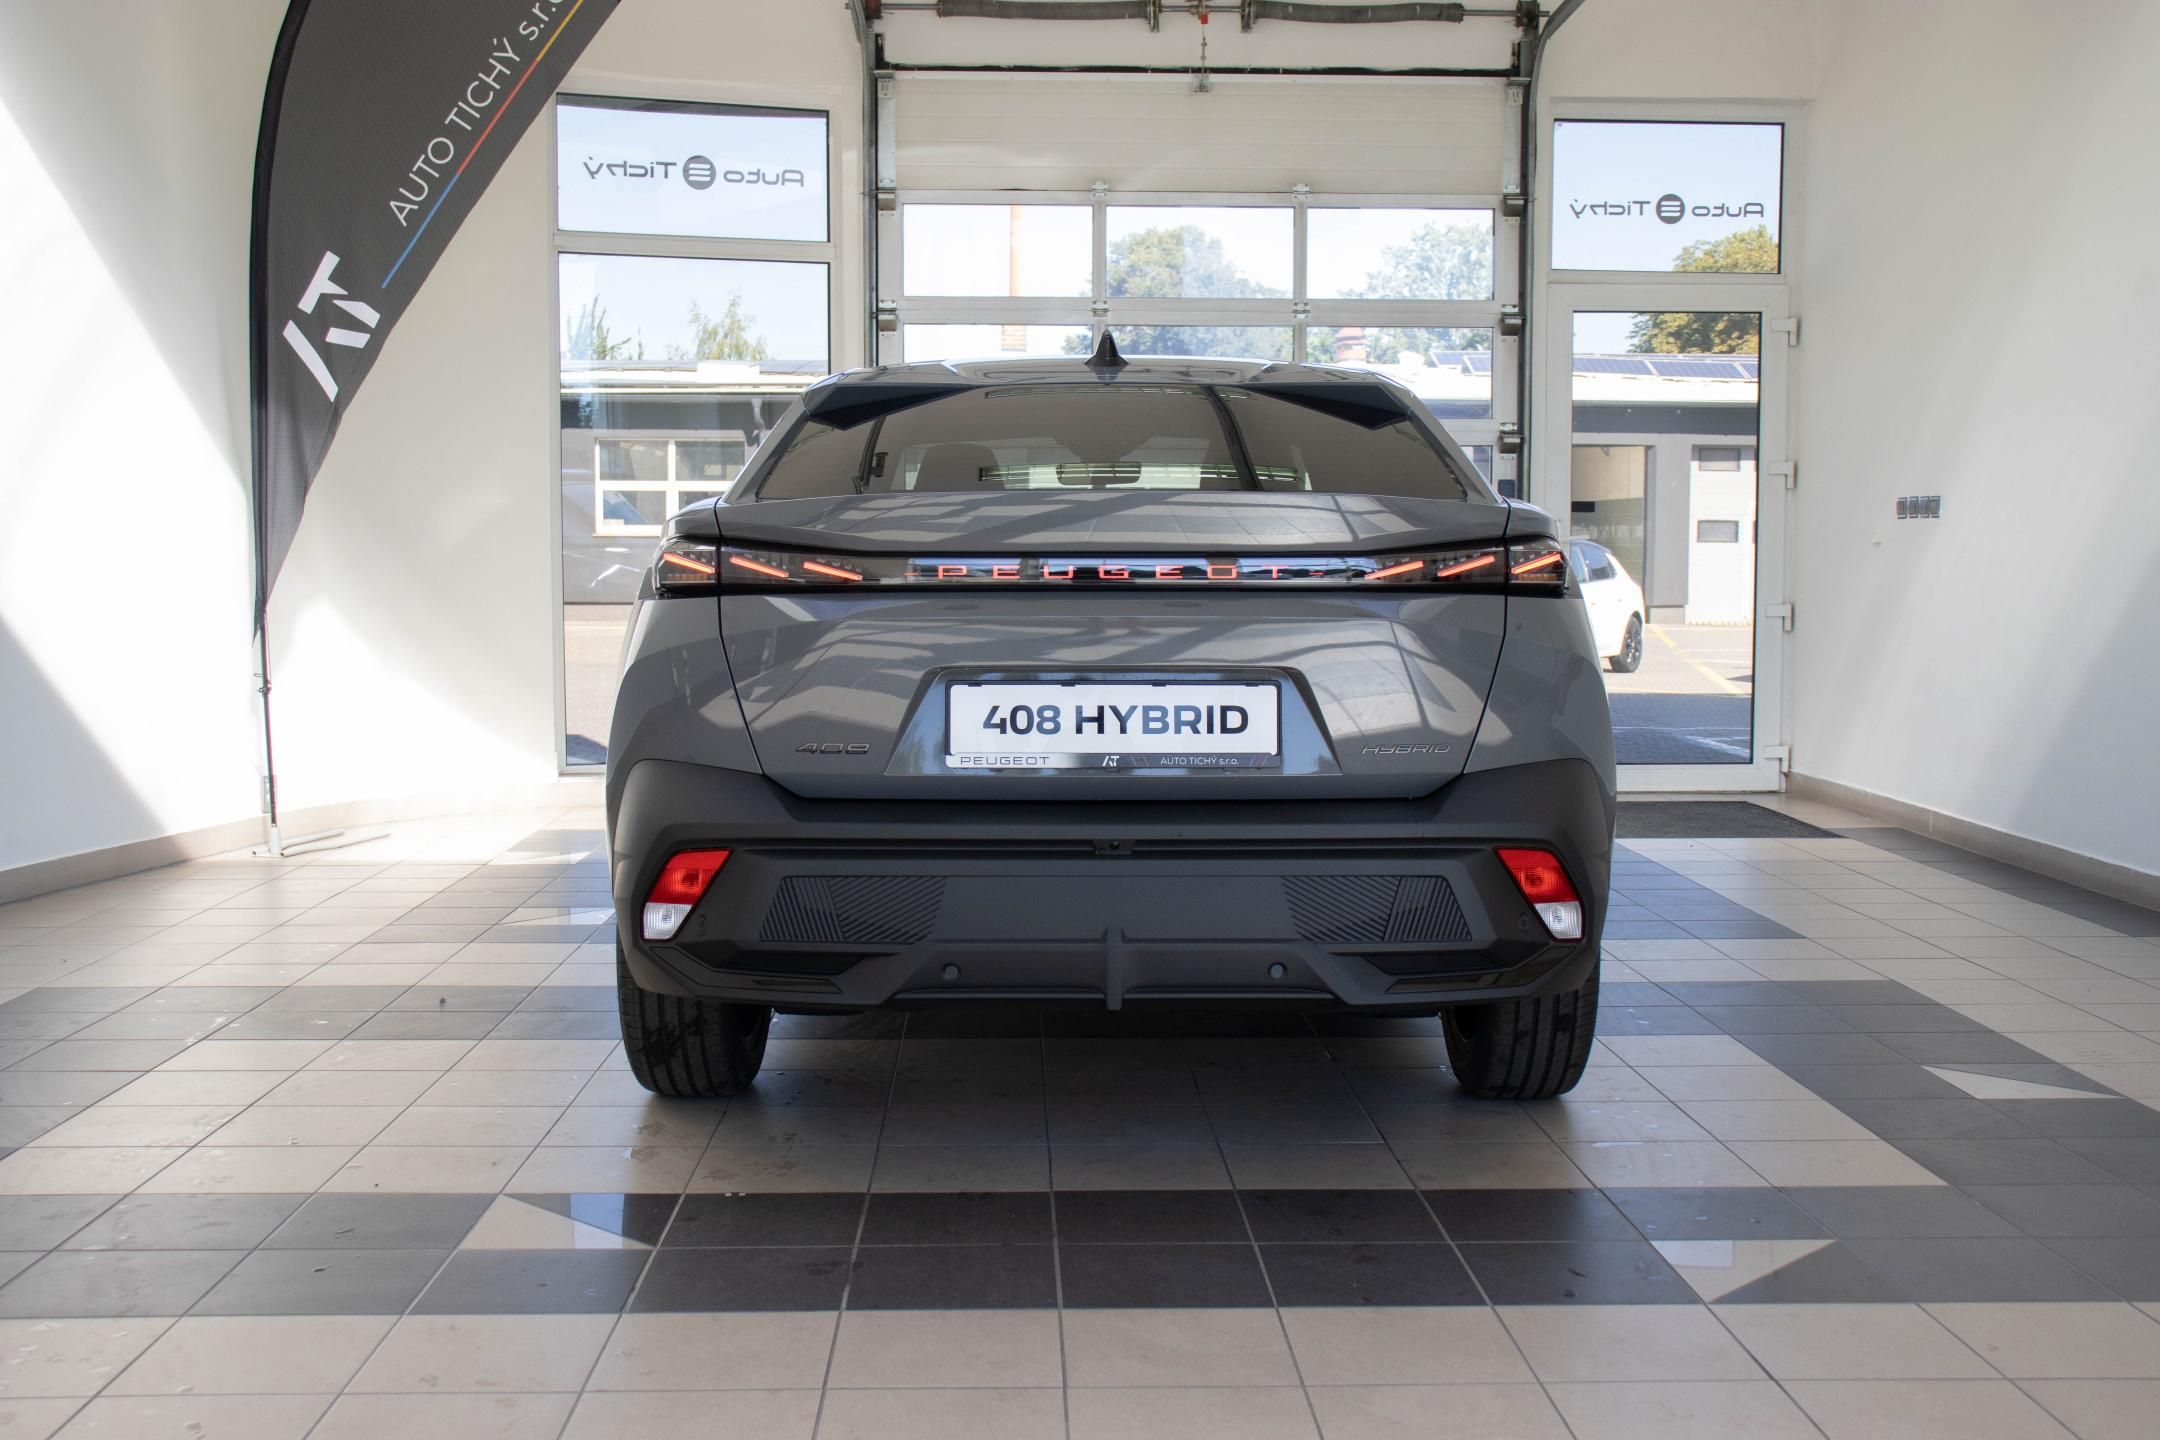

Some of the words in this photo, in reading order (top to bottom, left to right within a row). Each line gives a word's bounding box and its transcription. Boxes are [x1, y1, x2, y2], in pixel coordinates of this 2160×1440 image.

[389, 136, 455, 227] AUTO
[445, 37, 520, 130] TICHÝ
[519, 0, 561, 41] s.r.
[937, 565, 1289, 579] PEUGEOT
[982, 705, 1062, 735] 408
[1075, 705, 1249, 735] HYBRID
[1361, 744, 1452, 755] HYBRID
[960, 756, 1050, 765] PEUGEOT
[1160, 756, 1187, 765] AUTO
[1189, 754, 1217, 765] TICHÝ
[1219, 757, 1239, 765] s.r.o.
